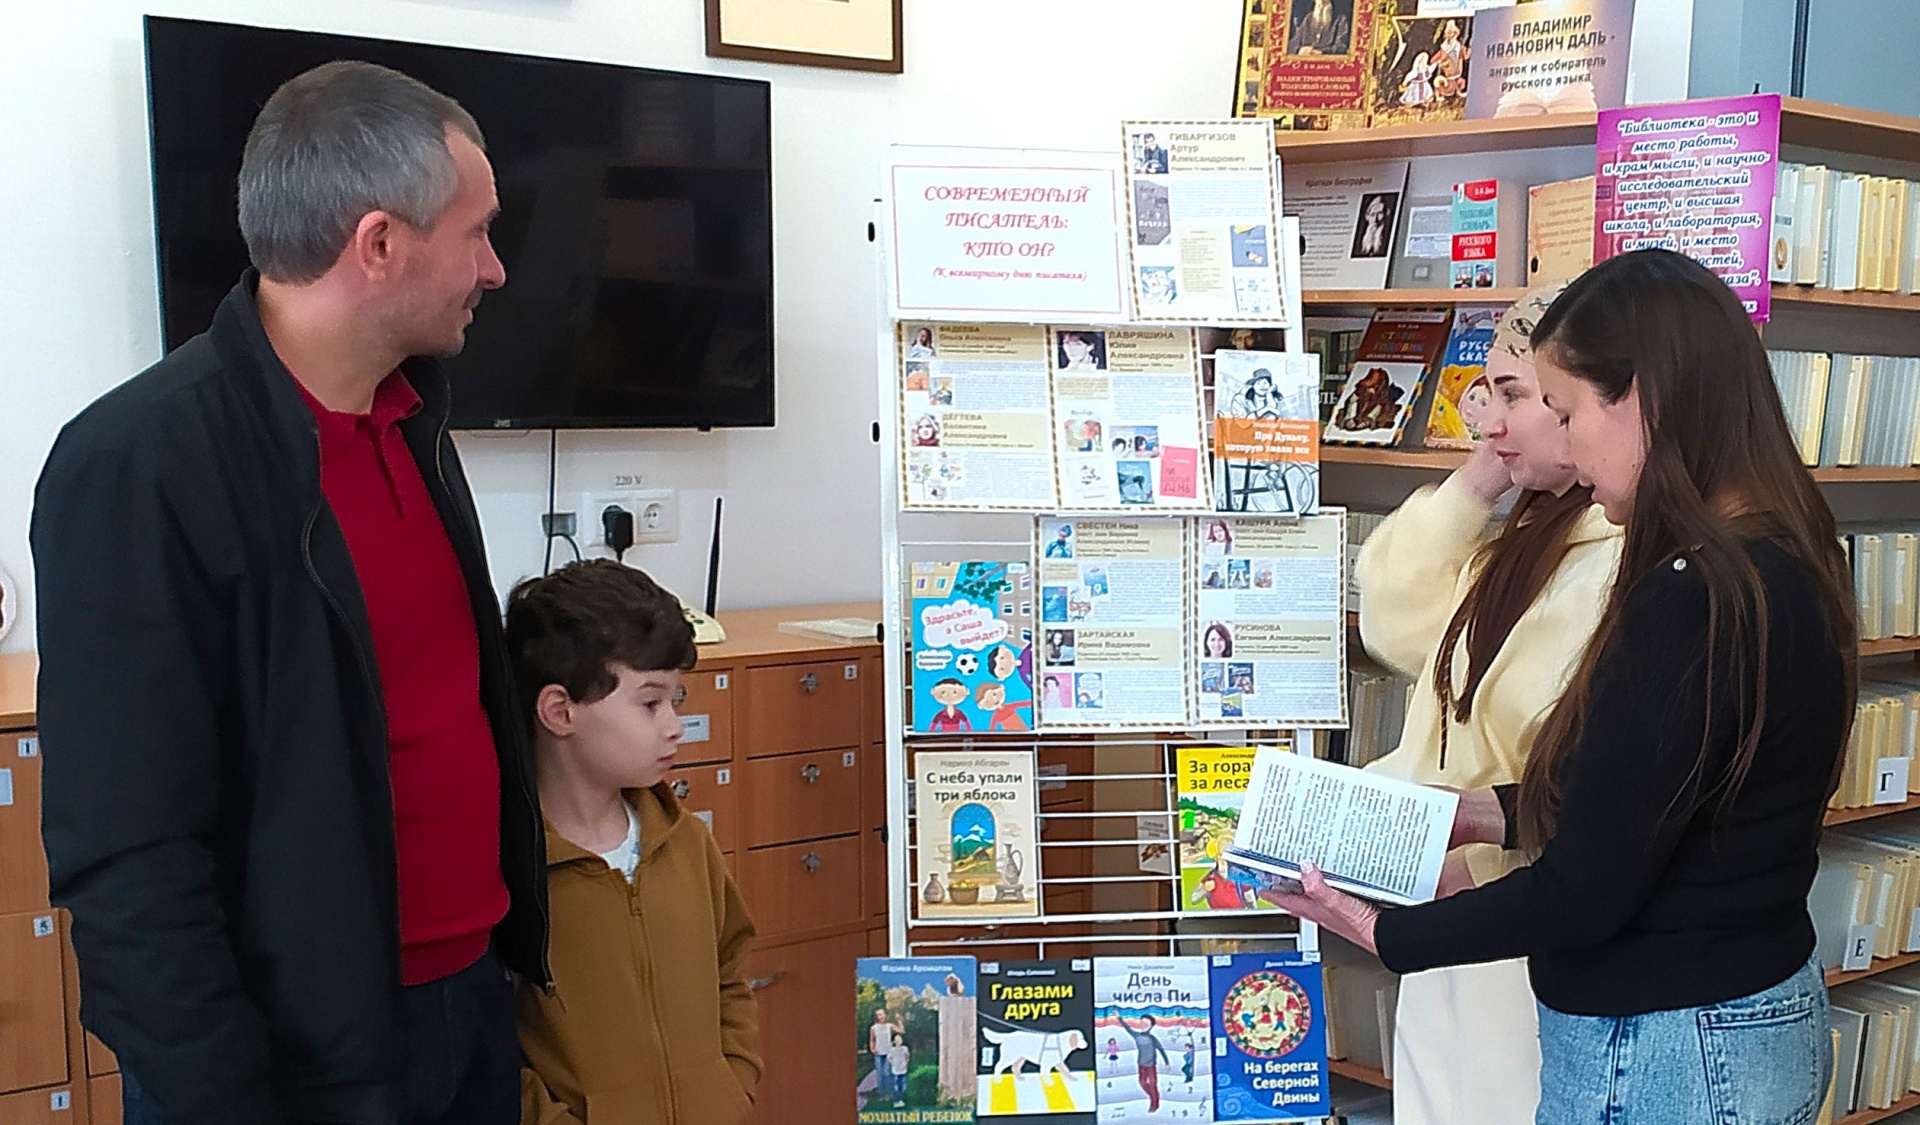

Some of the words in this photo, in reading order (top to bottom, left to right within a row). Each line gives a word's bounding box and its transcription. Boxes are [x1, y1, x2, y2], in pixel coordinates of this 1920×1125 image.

[1512, 15, 1591, 37] ВЛАДИМИР
[1486, 37, 1564, 58] ИВАНОВИЧ
[1567, 31, 1606, 49] ДАЛЬ
[1489, 65, 1527, 78] знаток
[1531, 64, 1537, 72] и
[1541, 56, 1606, 72] собиратель
[1501, 77, 1551, 92] русского
[1556, 73, 1590, 85] языка
[1717, 115, 1743, 125] это
[1748, 113, 1756, 122] и
[1170, 133, 1236, 141] ГИВАРГИЗОВ
[1634, 141, 1675, 152] место
[1680, 135, 1737, 151] работы,
[1170, 144, 1199, 152] Артур
[1171, 155, 1245, 163] Александрович
[1616, 162, 1648, 176] храм
[1652, 157, 1698, 171] мысли,
[1704, 157, 1711, 165] и
[1717, 153, 1768, 167] научно-
[1619, 174, 1748, 191] исследовательский
[924, 185, 1090, 203] СОВРЕМЕННЫЙ
[1625, 200, 1670, 213] центр,
[1675, 199, 1682, 207] и
[1687, 195, 1740, 207] высшая
[945, 212, 1069, 230] ПИСАТЕЛЬ:
[1605, 220, 1650, 231] школа,
[1655, 220, 1662, 228] и
[1666, 214, 1760, 229] лаборатория,
[963, 242, 1013, 258] КТО
[1018, 242, 1055, 257] ОН?
[1624, 241, 1632, 249] и
[1636, 237, 1677, 250] музей,
[1683, 238, 1690, 246] и
[1694, 235, 1737, 246] место
[933, 266, 948, 279] (К
[1013, 269, 1033, 278] дню
[1036, 271, 1087, 281] писателя)
[1459, 340, 1490, 351] РУСС
[1110, 352, 1184, 360] Александровна
[1225, 444, 1264, 454] которую
[615, 475, 633, 486] 220
[634, 475, 643, 485] V
[925, 607, 977, 626] Здрасьте,
[946, 627, 952, 635] а
[954, 620, 983, 633] Саша
[960, 627, 1005, 646] выйдет?
[1189, 760, 1208, 773] За
[1213, 760, 1253, 775] гора
[926, 772, 936, 784] С
[940, 771, 975, 784] неба
[978, 774, 1022, 786] упали
[1189, 779, 1208, 790] за
[1880, 772, 1894, 792] Г
[934, 791, 960, 803] три
[964, 788, 1016, 801] яблока
[1855, 938, 1866, 957] Е
[1127, 972, 1172, 990] День
[991, 983, 1074, 1001] Глазами
[1113, 992, 1163, 1003] числа
[1168, 989, 1191, 1003] Пи
[1004, 1002, 1061, 1021] друга
[1244, 1063, 1263, 1074] На
[1265, 1061, 1319, 1075] берегах
[1252, 1074, 1320, 1091] Северной
[1272, 1092, 1321, 1107] Двины
